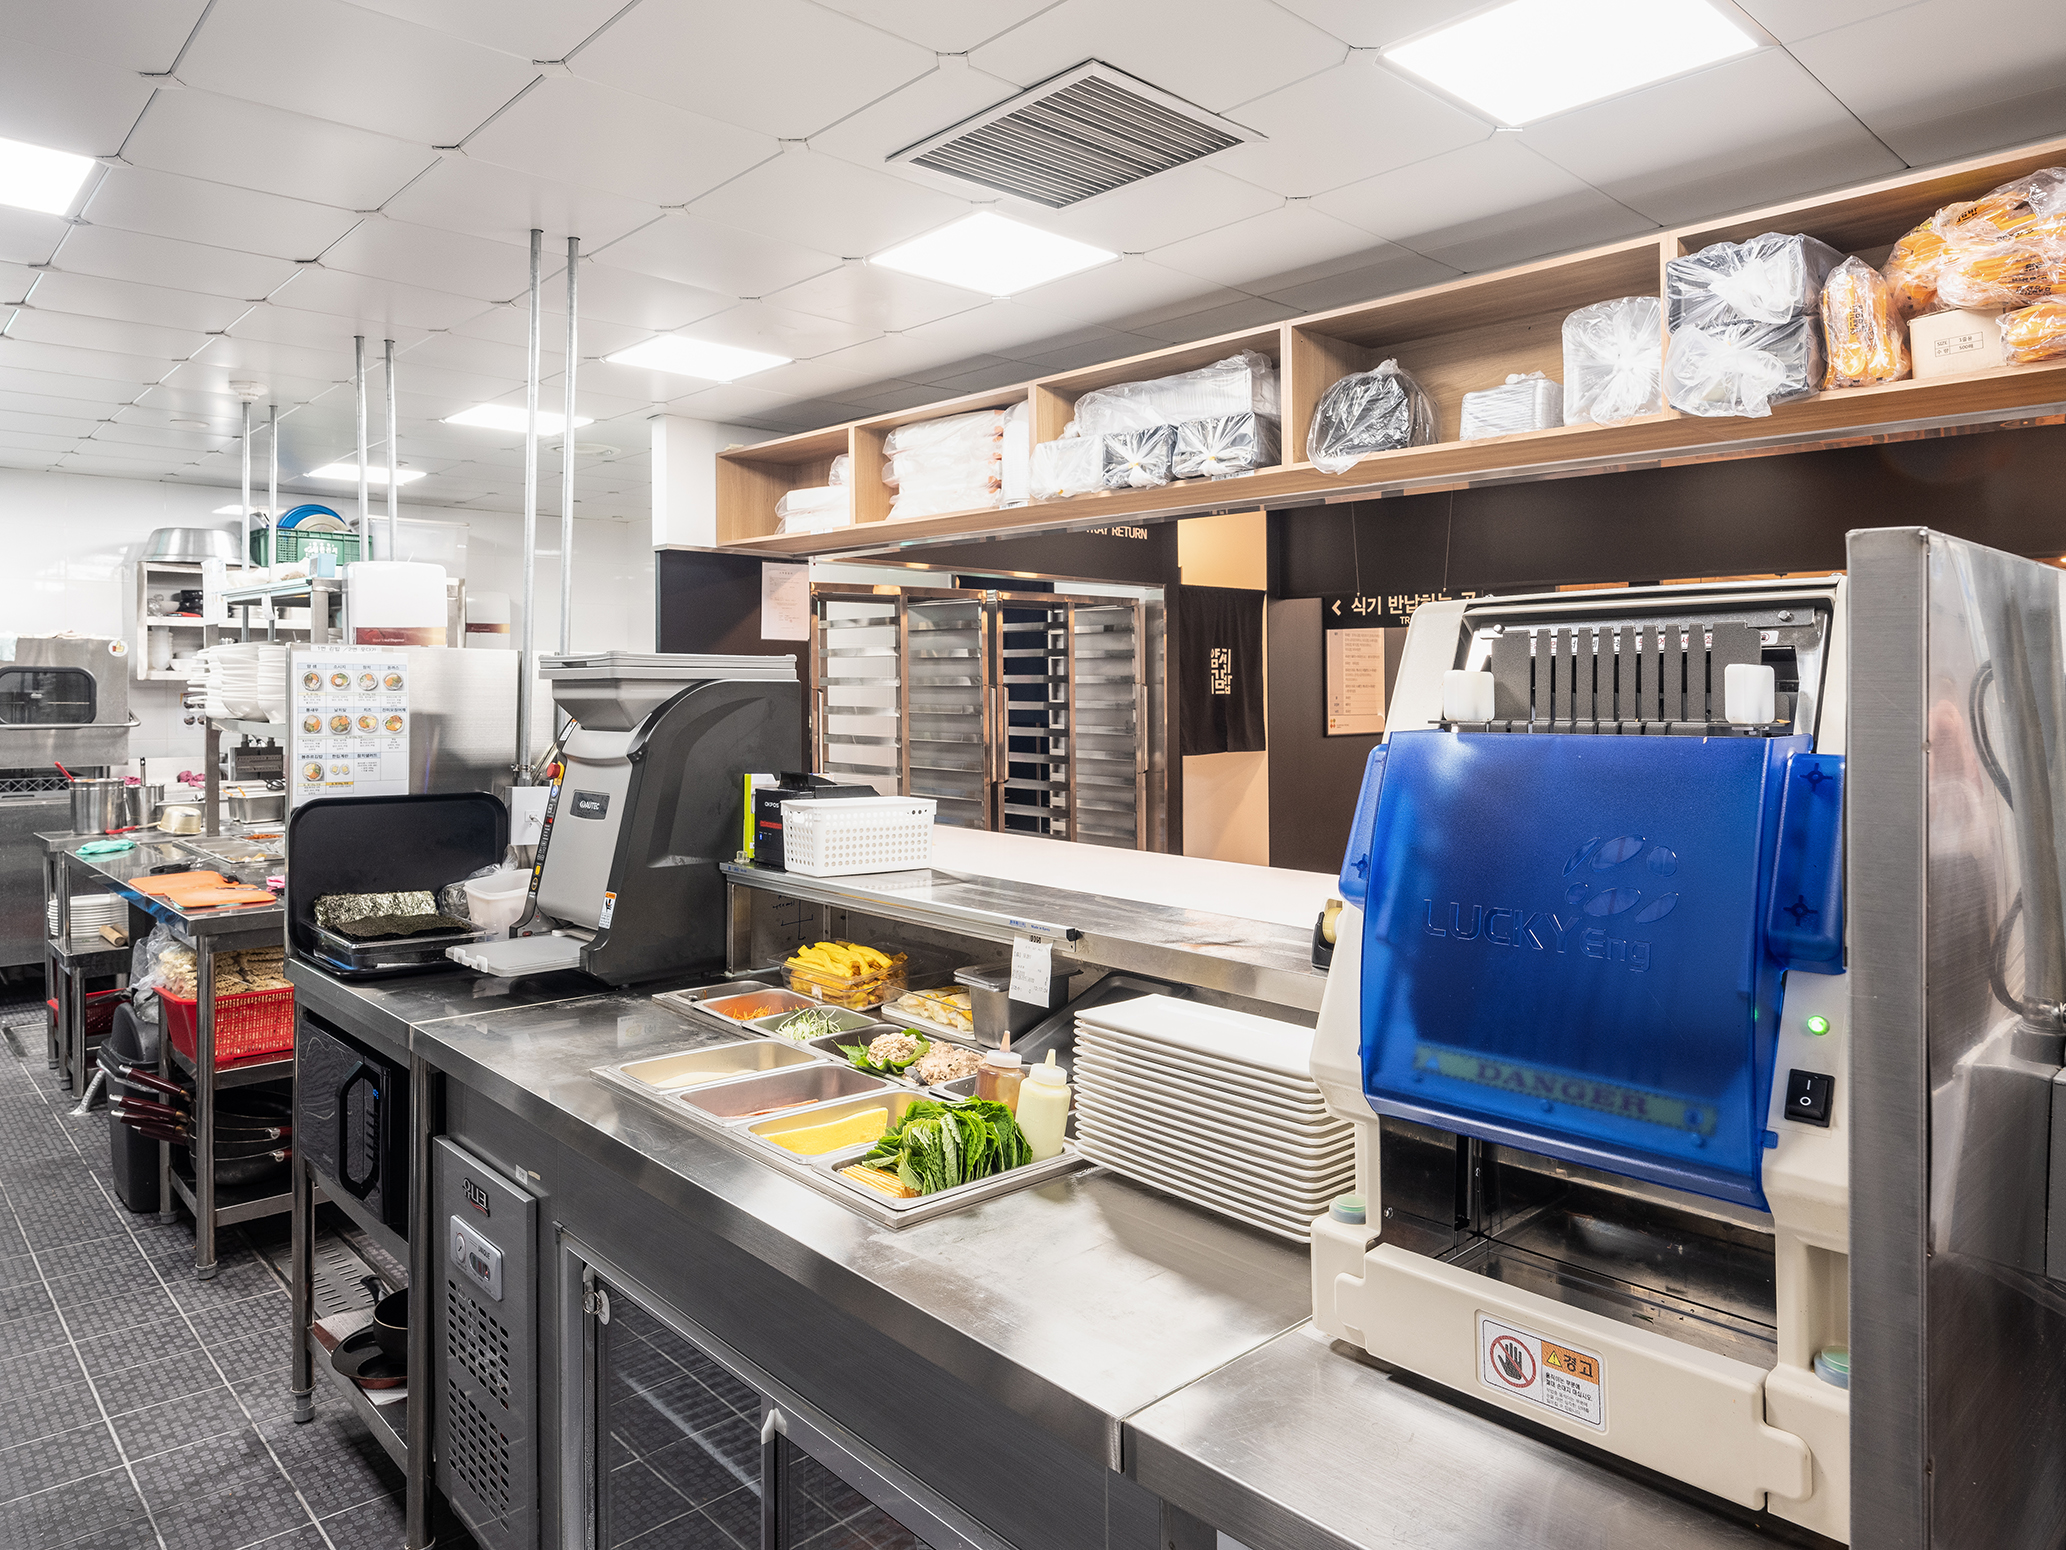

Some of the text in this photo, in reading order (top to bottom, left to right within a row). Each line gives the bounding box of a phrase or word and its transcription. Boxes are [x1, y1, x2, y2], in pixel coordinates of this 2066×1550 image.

[1111, 526, 1148, 540] RETURN
[1351, 595, 1382, 616] 식기
[1423, 898, 1652, 973] LUCKY Eng
[1476, 1062, 1649, 1116] DANGER
[478, 1245, 491, 1260] UNIQUE
[1564, 1354, 1594, 1378] 경고
